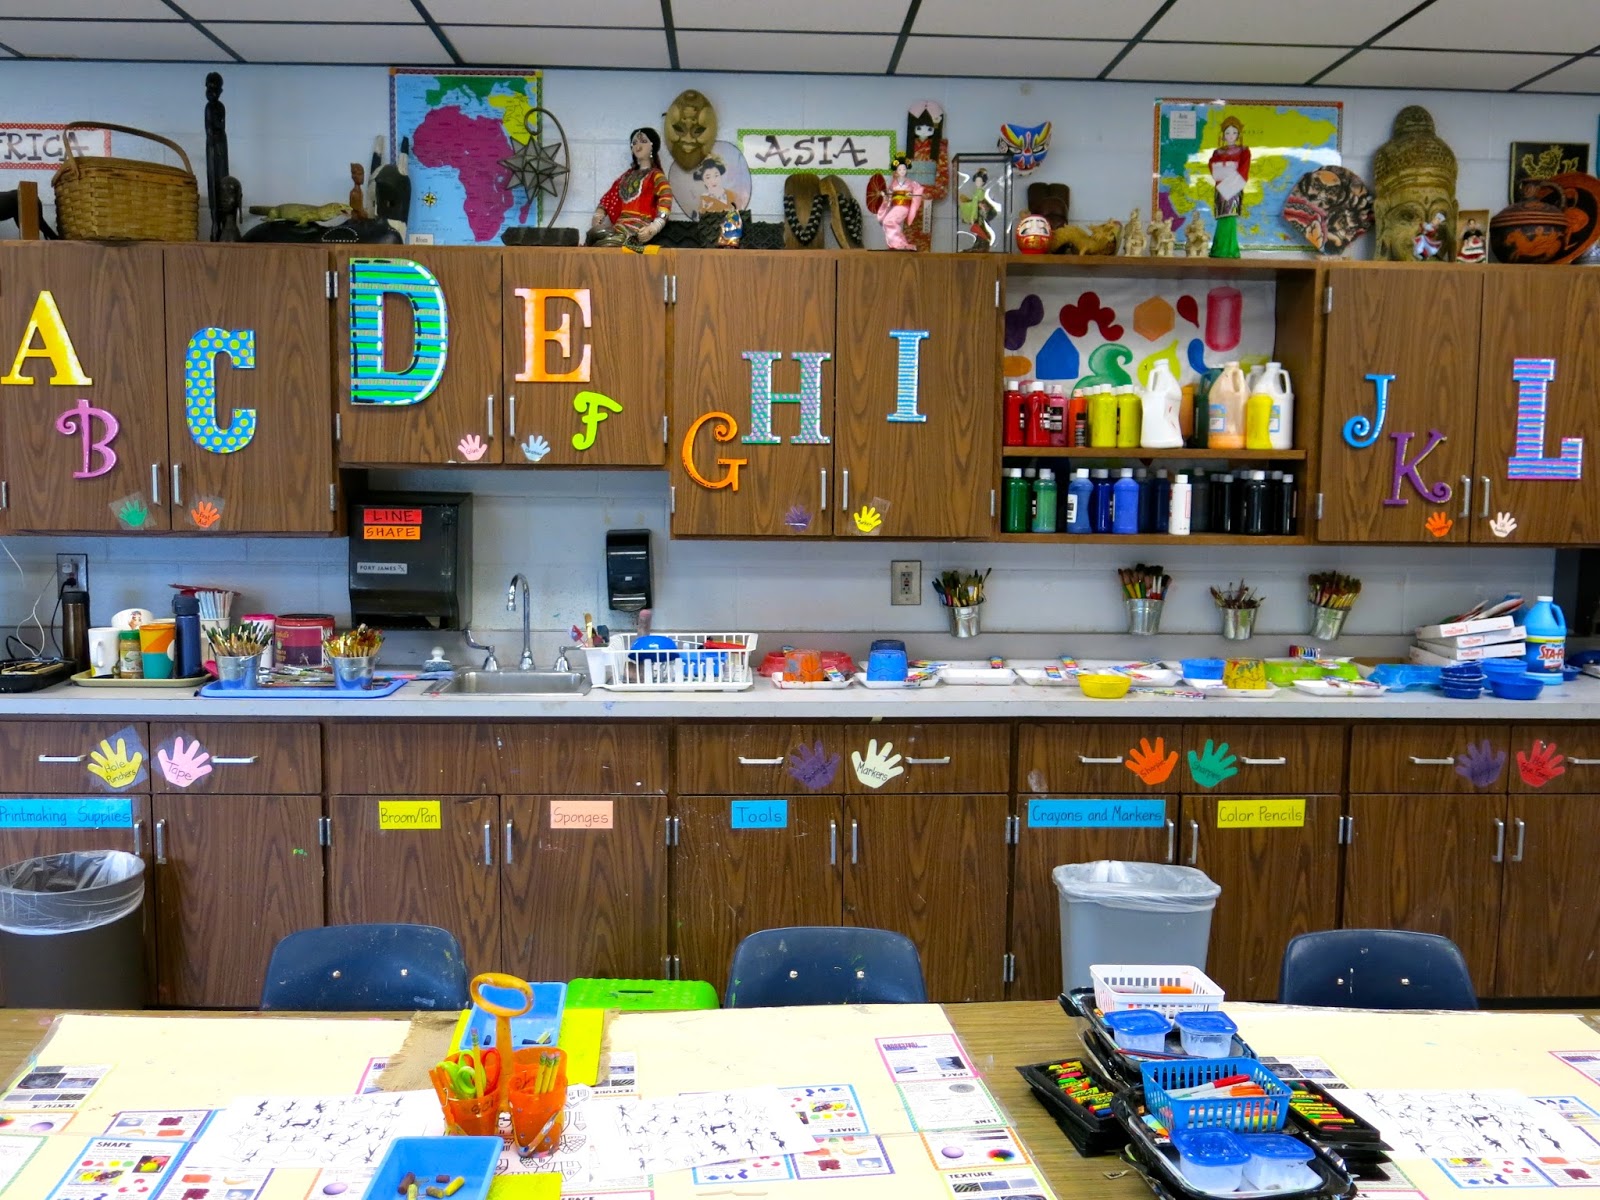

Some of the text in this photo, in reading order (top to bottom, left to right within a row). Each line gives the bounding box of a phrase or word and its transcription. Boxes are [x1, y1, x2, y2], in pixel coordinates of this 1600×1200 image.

[755, 135, 868, 167] ASIA
[0, 290, 93, 386] A
[349, 257, 448, 406] D
[514, 287, 592, 383] E
[185, 326, 257, 454] C
[741, 351, 832, 445] H
[886, 329, 930, 422] I
[572, 390, 624, 451] F
[1341, 373, 1396, 448] J
[1507, 358, 1584, 480] L
[55, 398, 120, 479] B
[681, 411, 748, 492] G
[1382, 428, 1453, 505] K
[366, 527, 416, 537] SHAPE
[372, 510, 415, 522] LINE
[104, 760, 127, 773] Hole
[165, 759, 193, 782] Tape
[856, 761, 888, 782] Markers
[0, 805, 131, 826] Printmaking Supplies
[553, 806, 609, 827] Sponges
[736, 806, 783, 823] Tools
[1032, 805, 1163, 826] Crayons and Markers
[1218, 806, 1303, 822] Color Pencils
[948, 1171, 995, 1179] TEXTURE
